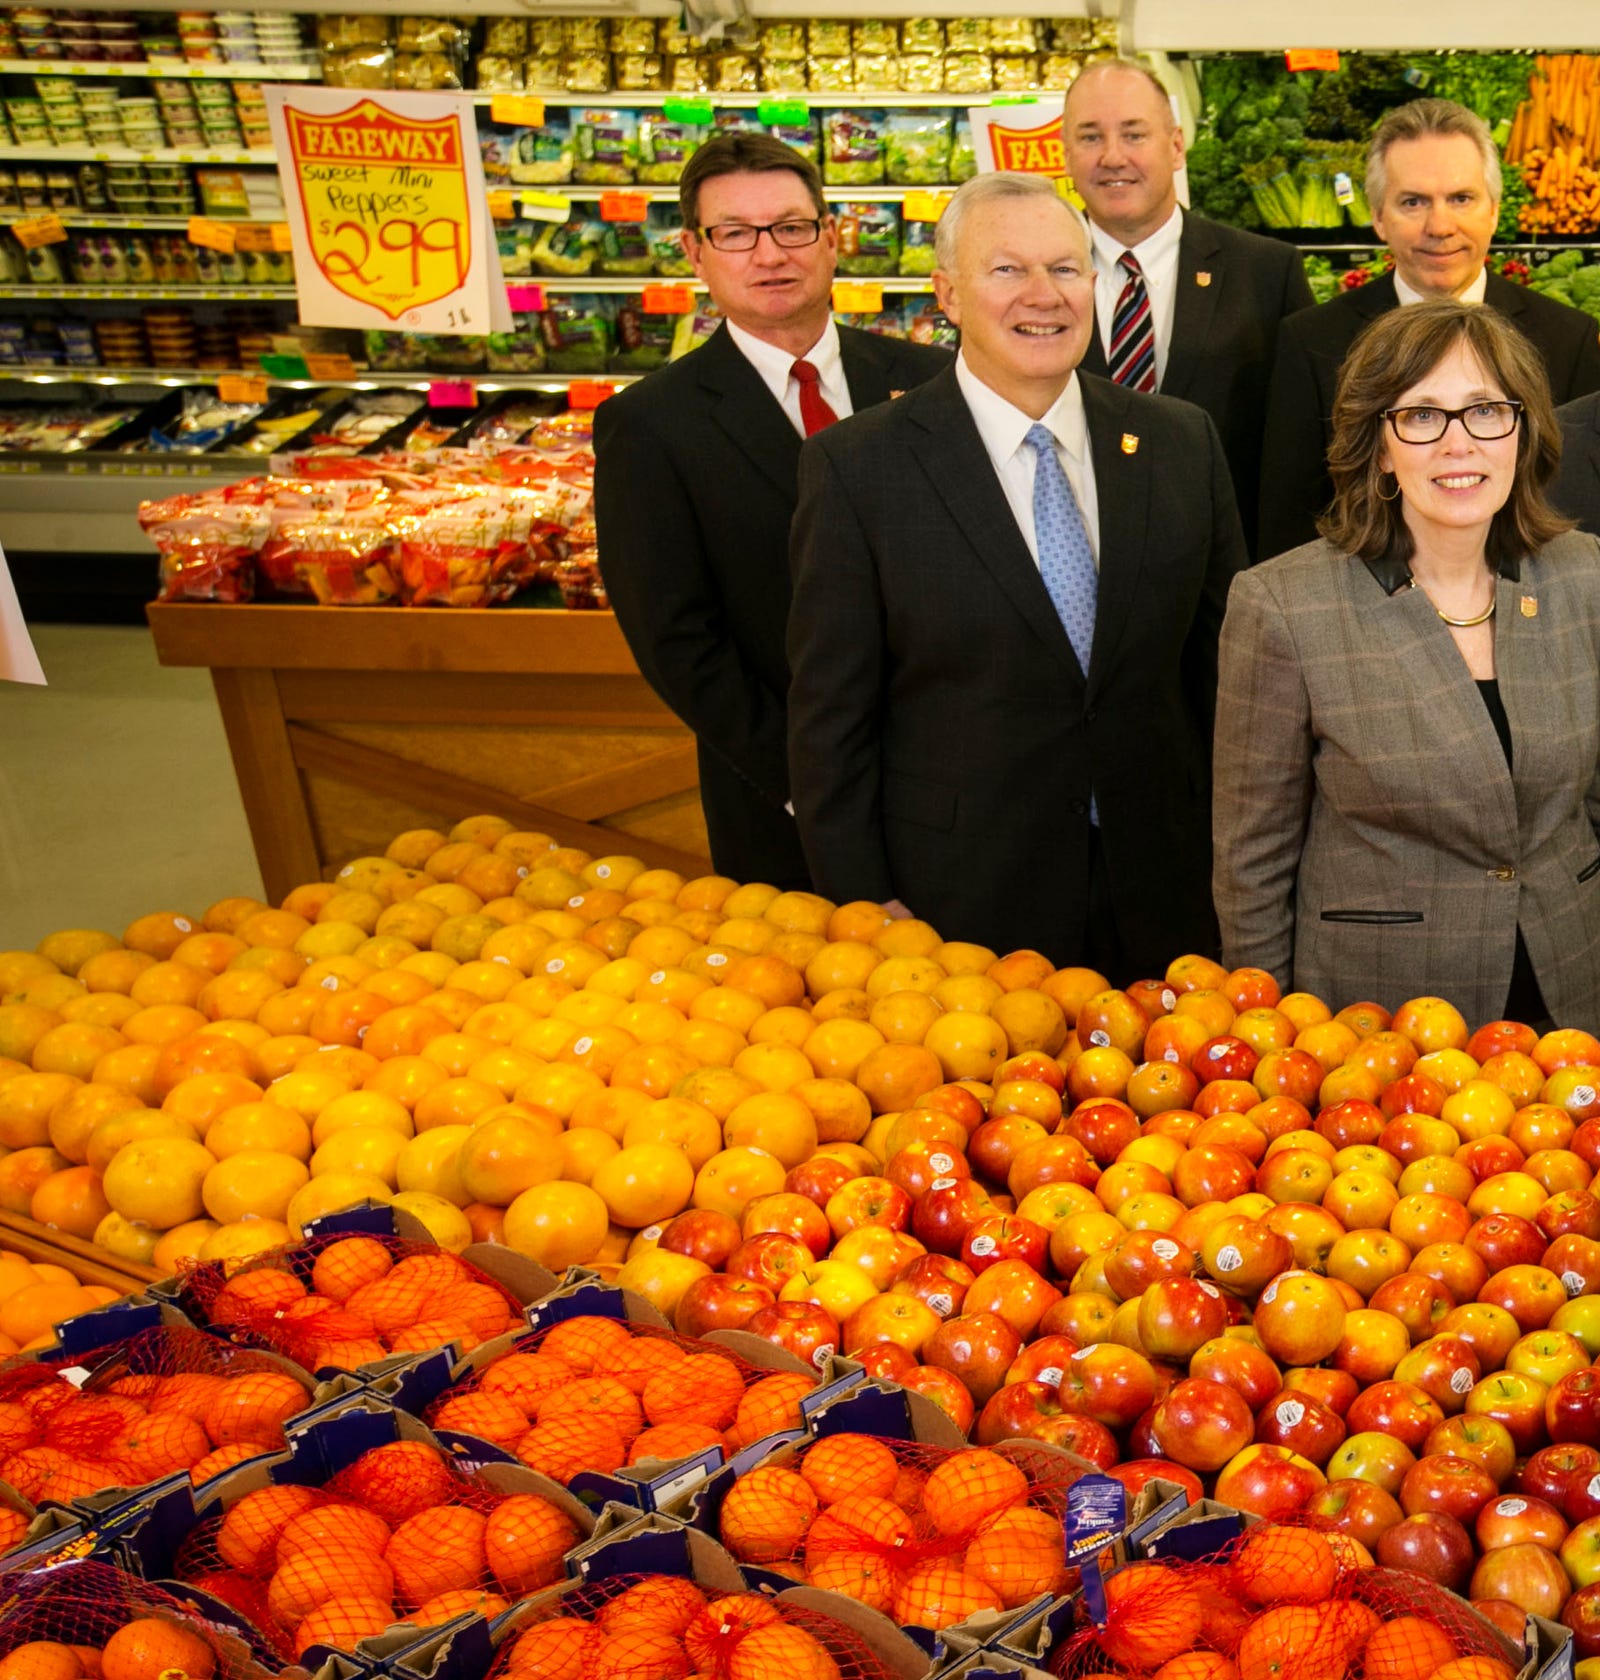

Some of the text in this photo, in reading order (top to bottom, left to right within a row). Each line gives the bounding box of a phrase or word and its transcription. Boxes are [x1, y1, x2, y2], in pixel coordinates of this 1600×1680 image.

[303, 125, 450, 160] FAREWAY
[390, 165, 433, 188] Mini
[326, 186, 429, 224] Peppers
